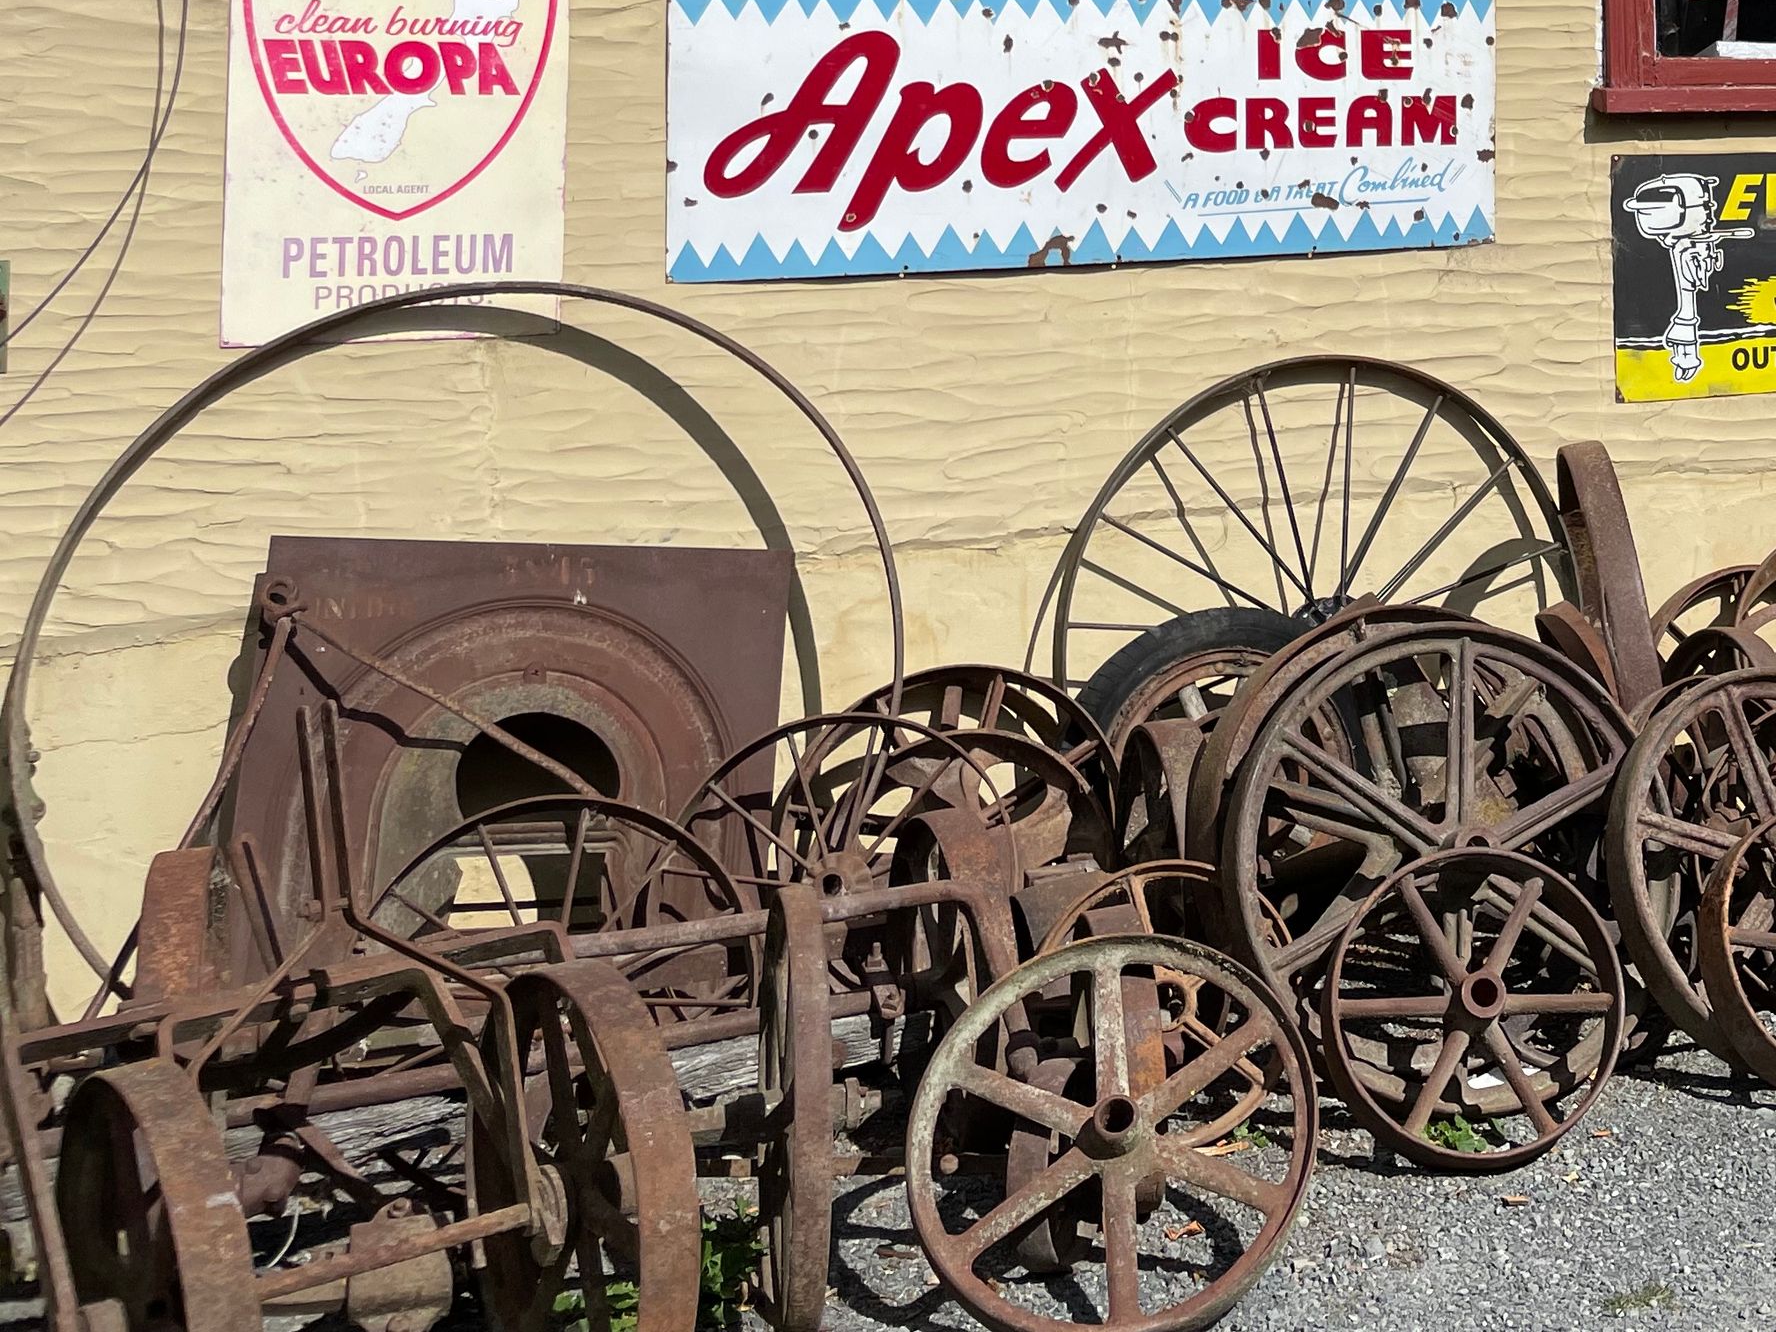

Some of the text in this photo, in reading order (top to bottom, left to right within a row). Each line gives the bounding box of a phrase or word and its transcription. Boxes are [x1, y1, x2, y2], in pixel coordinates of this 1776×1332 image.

[386, 5, 524, 47] burning
[262, 38, 521, 96] EUROPA
[1257, 29, 1414, 81] ICE
[702, 30, 1178, 232] Apex
[1183, 95, 1457, 153] CREAM
[363, 185, 429, 194] LOCAL AGENT
[1182, 192, 1200, 210] A
[1202, 189, 1250, 208] FOOD
[1267, 186, 1281, 202] A
[1339, 157, 1455, 207] Combined
[282, 233, 514, 278] PETROLEUM
